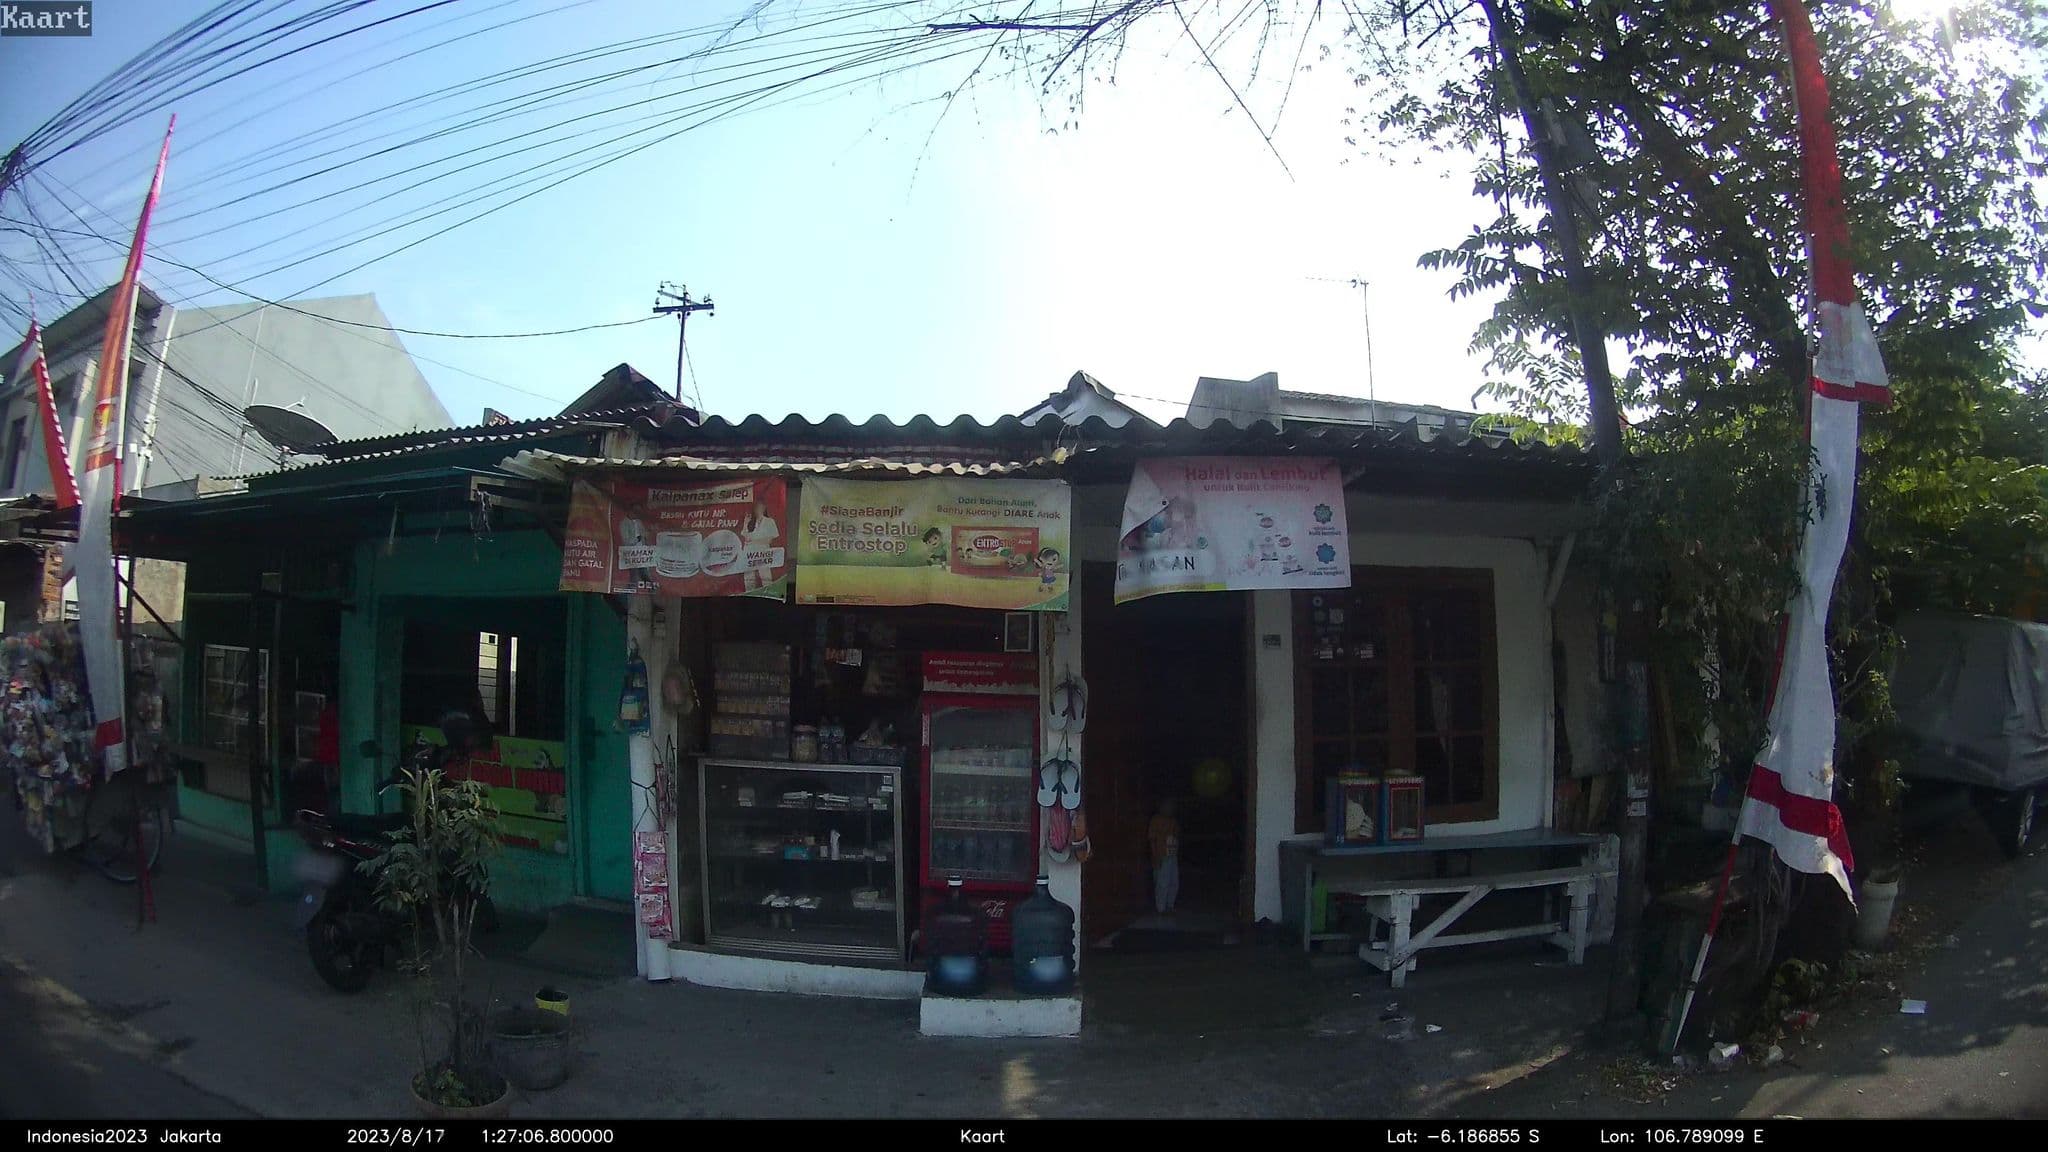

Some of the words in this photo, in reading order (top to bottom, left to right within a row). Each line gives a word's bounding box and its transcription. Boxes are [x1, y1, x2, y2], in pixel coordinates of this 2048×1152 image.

[1184, 464, 1231, 481] Halal
[1234, 470, 1257, 480] dan
[1260, 464, 1327, 481] Lembut
[652, 489, 715, 503] Kalpanax
[821, 504, 904, 518] #SiagaBanjir
[1004, 509, 1034, 518] DIARE
[1037, 510, 1061, 520] Anak
[691, 519, 715, 529] GATAL
[809, 520, 857, 535] Sedia
[862, 521, 918, 537] Selalu
[817, 536, 907, 557] Entrostop
[746, 550, 774, 560] WANGI
[578, 559, 605, 569] GATAL
